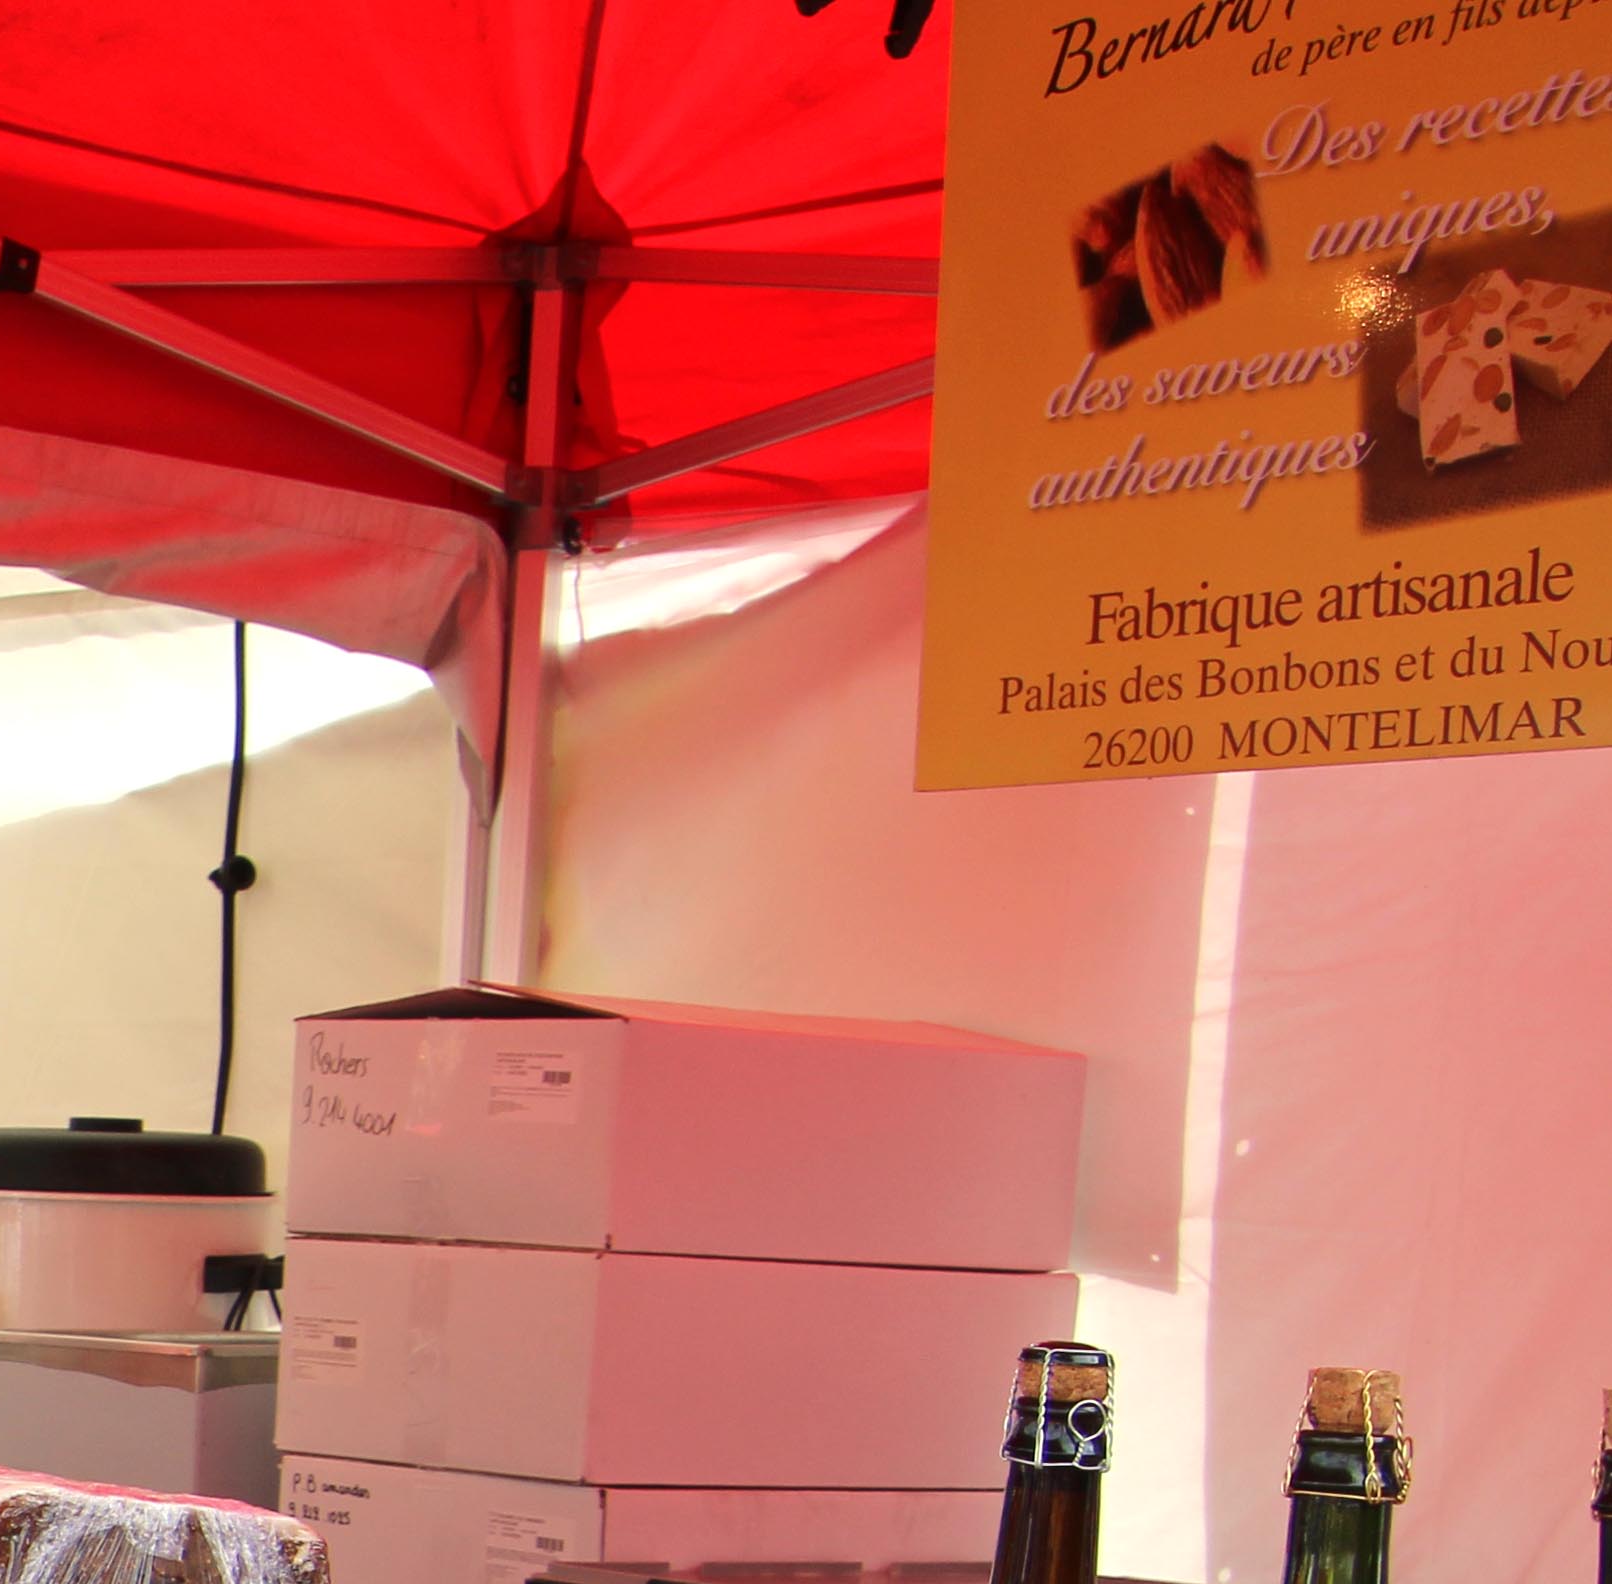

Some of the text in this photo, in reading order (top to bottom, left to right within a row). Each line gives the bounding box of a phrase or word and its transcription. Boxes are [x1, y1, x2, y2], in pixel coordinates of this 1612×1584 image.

[1252, 39, 1293, 77] de
[1299, 26, 1383, 76] père
[1393, 15, 1436, 47] en
[1253, 99, 1390, 180] Des
[1306, 184, 1558, 274] uniques,
[1045, 336, 1370, 420] des saveurs
[1028, 428, 1376, 512] authentiques
[1085, 547, 1576, 648] Fabrique artisanale
[997, 669, 1108, 715] Palais
[1120, 665, 1184, 704] des
[1195, 657, 1382, 700] Bonbons
[1394, 644, 1436, 682] et
[1449, 636, 1506, 679] du
[1083, 696, 1589, 770] 26200 MONTELIMAR
